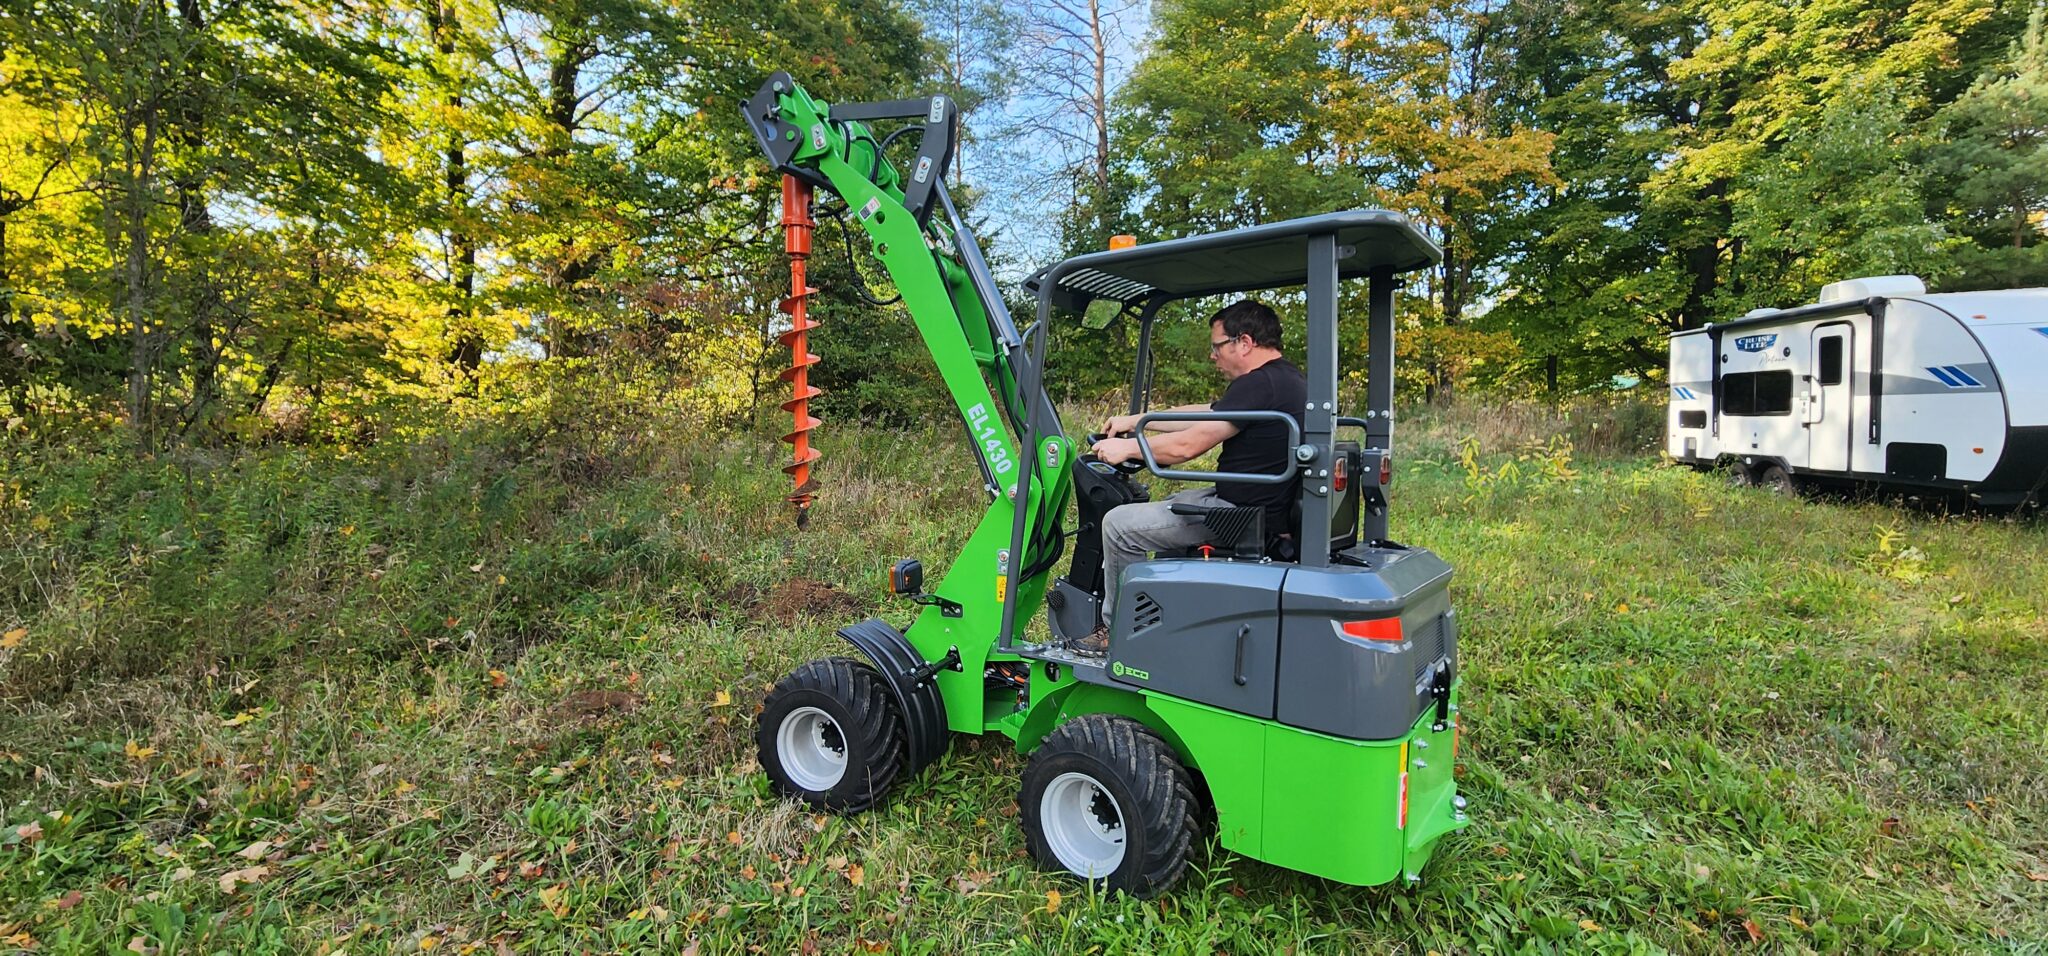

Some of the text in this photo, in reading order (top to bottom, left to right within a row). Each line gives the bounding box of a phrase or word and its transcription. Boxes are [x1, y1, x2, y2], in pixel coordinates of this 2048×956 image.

[1738, 335, 1774, 345] CRUISE
[967, 402, 1012, 474] EL1430
[1125, 666, 1149, 680] ECO
